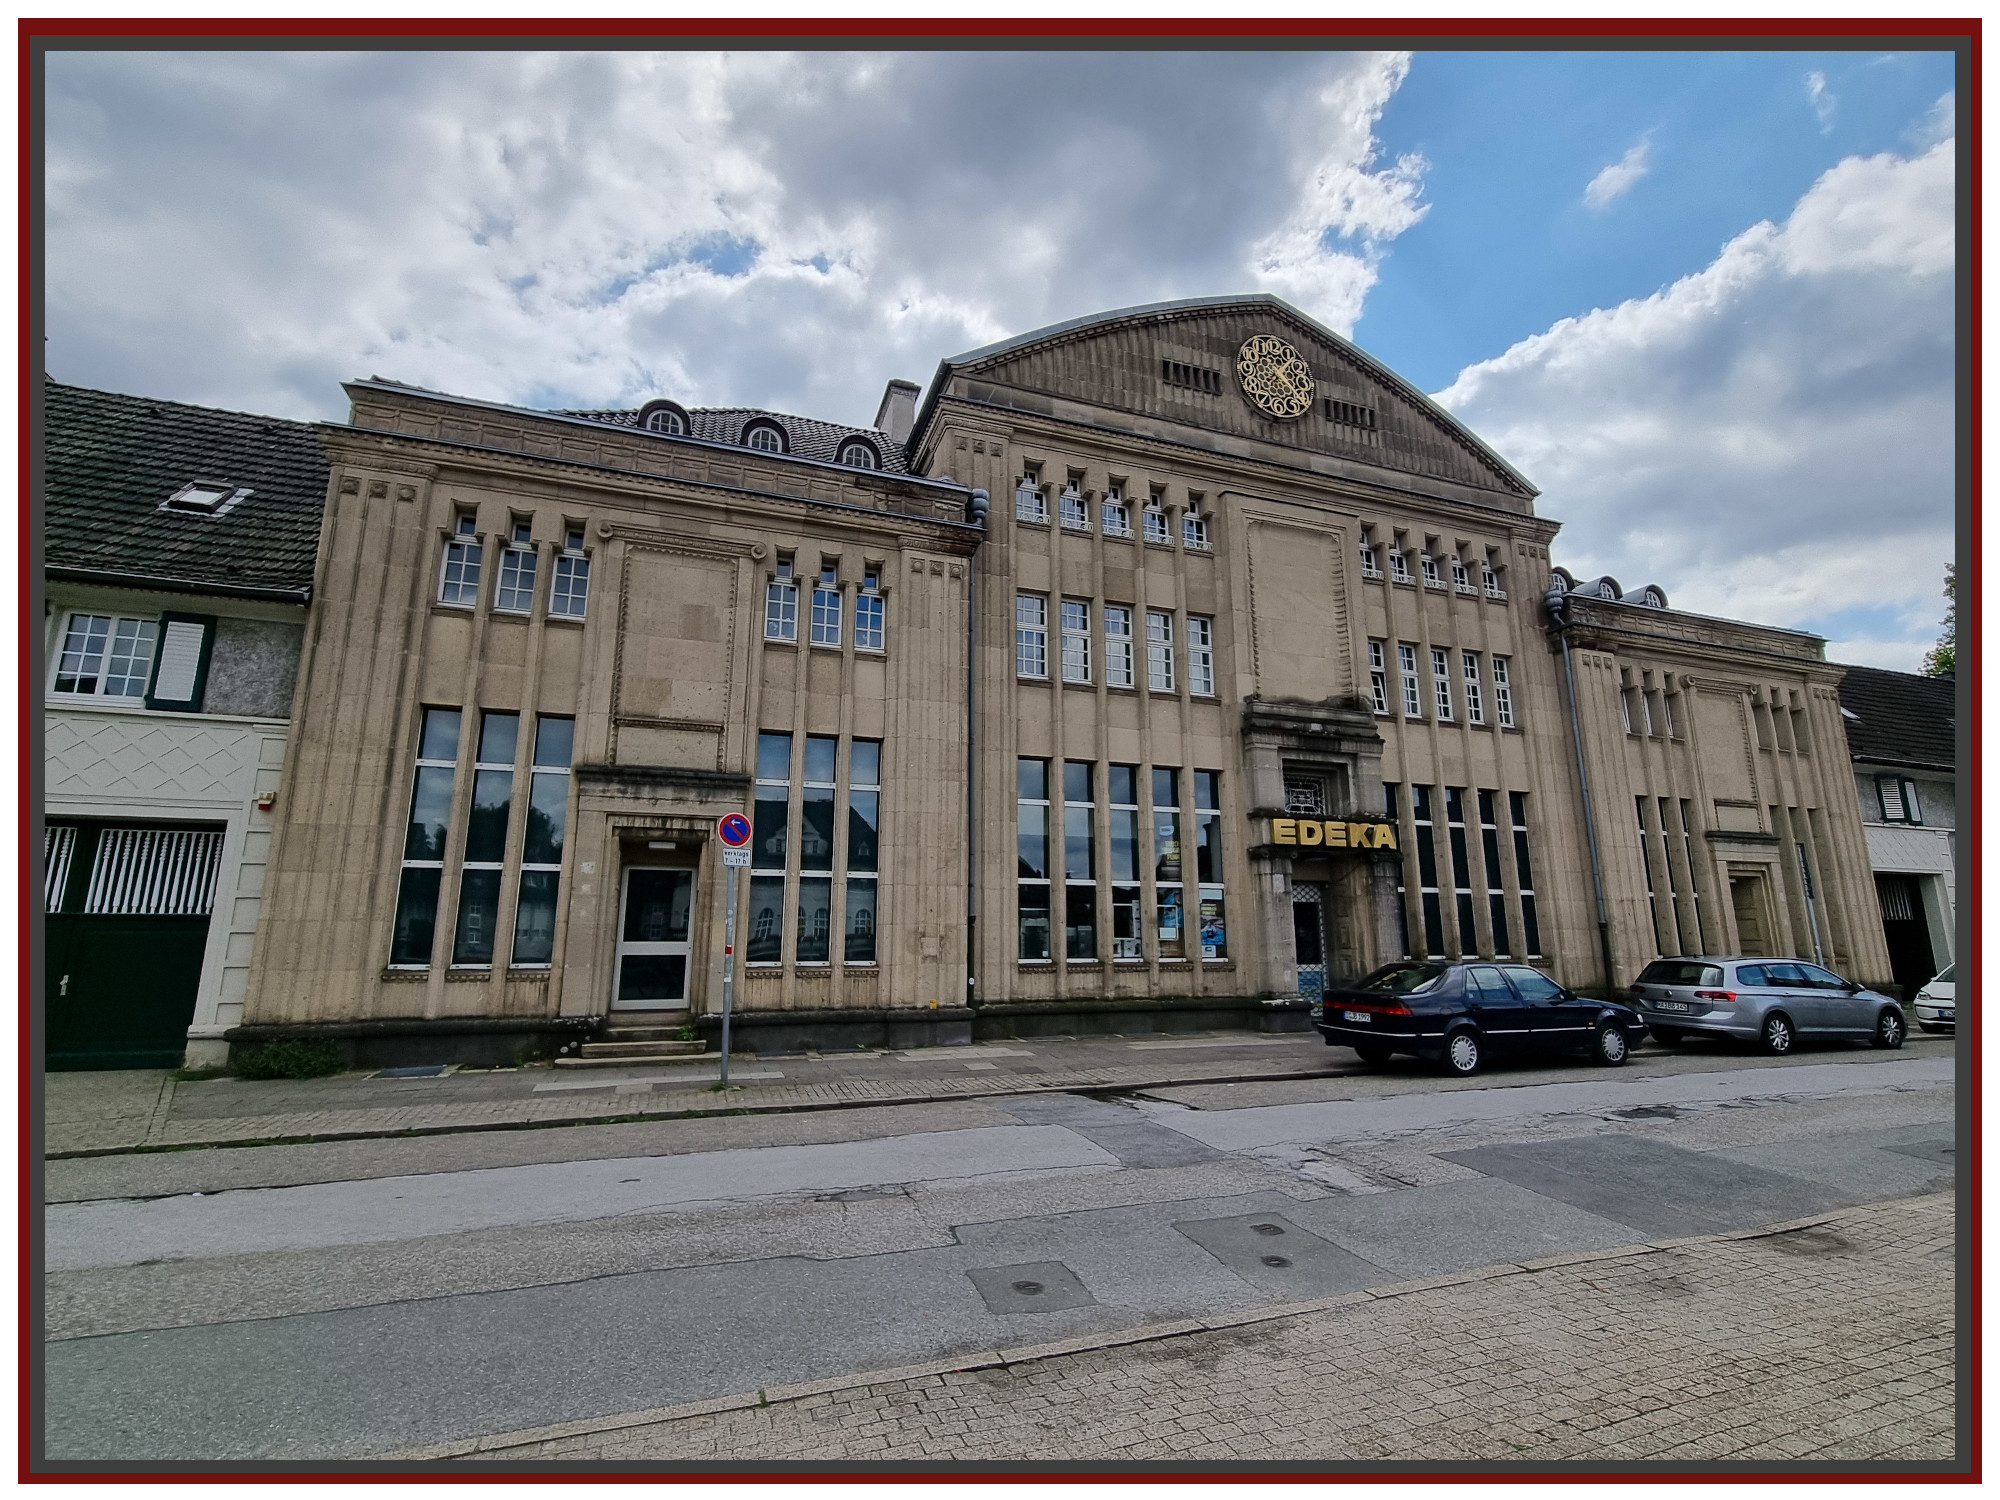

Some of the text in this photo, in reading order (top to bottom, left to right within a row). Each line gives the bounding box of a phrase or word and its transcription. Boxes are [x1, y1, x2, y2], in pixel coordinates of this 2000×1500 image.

[1254, 340, 1266, 354] 11
[1269, 340, 1280, 353] 12
[1244, 348, 1259, 363] 10
[1243, 362, 1254, 376] 9
[1295, 362, 1304, 373] 2
[1247, 376, 1258, 392] 8
[1300, 376, 1310, 391] 3
[1257, 390, 1270, 404] 7
[1273, 398, 1284, 414] 6
[1288, 397, 1298, 413] 5
[1272, 818, 1397, 849] EDEKA
